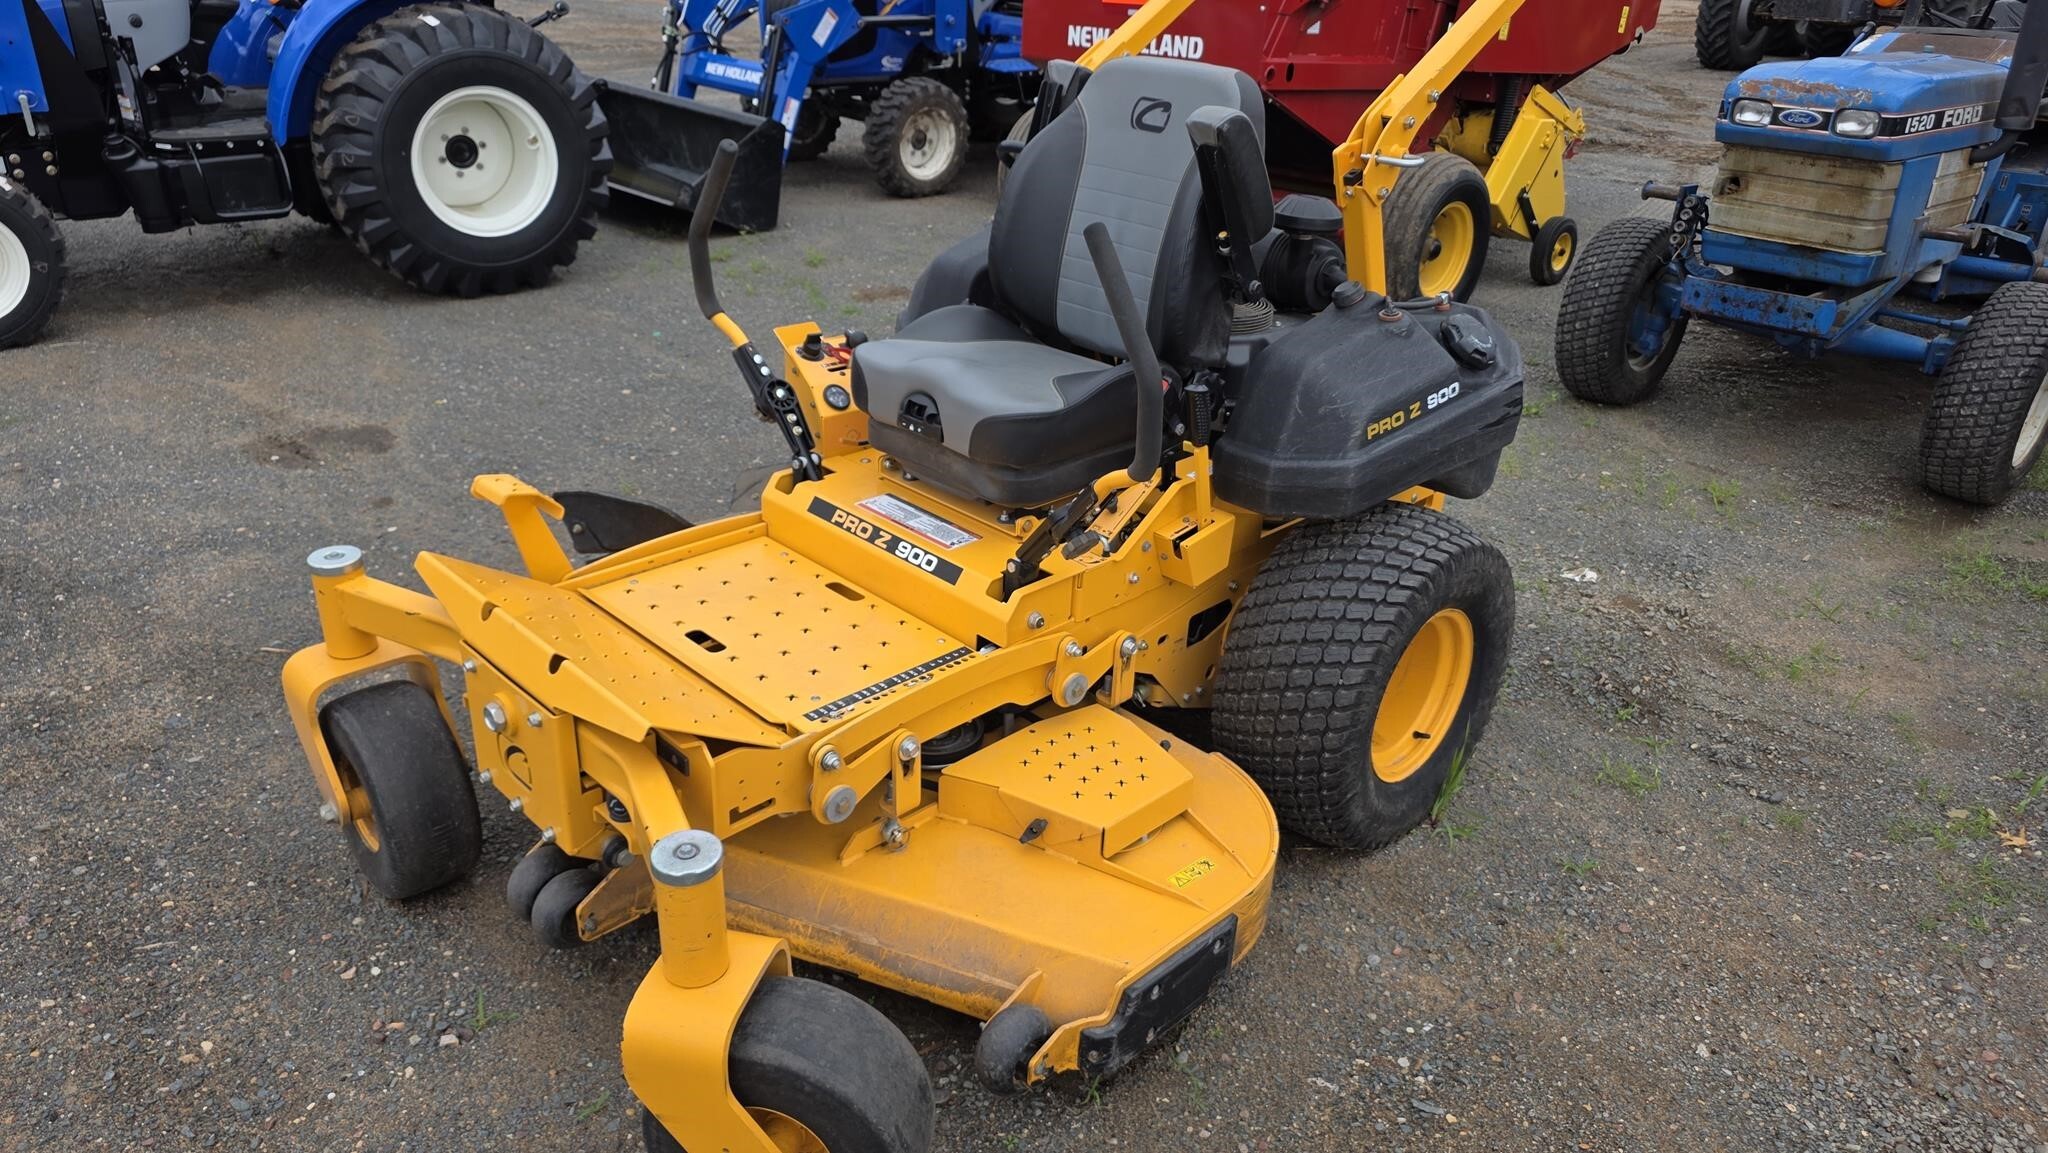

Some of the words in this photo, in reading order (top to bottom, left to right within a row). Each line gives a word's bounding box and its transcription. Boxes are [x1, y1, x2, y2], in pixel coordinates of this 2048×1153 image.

[1067, 24, 1110, 48] NEW
[1140, 33, 1204, 60] LAND
[705, 61, 726, 77] NEW
[1904, 113, 1936, 134] 1520
[1941, 105, 1983, 128] FORD
[1367, 410, 1405, 440] PRO
[1409, 401, 1421, 419] Z
[1427, 381, 1460, 409] 900
[831, 509, 874, 540] PRO
[874, 531, 893, 549] Z
[895, 541, 938, 572] 900
